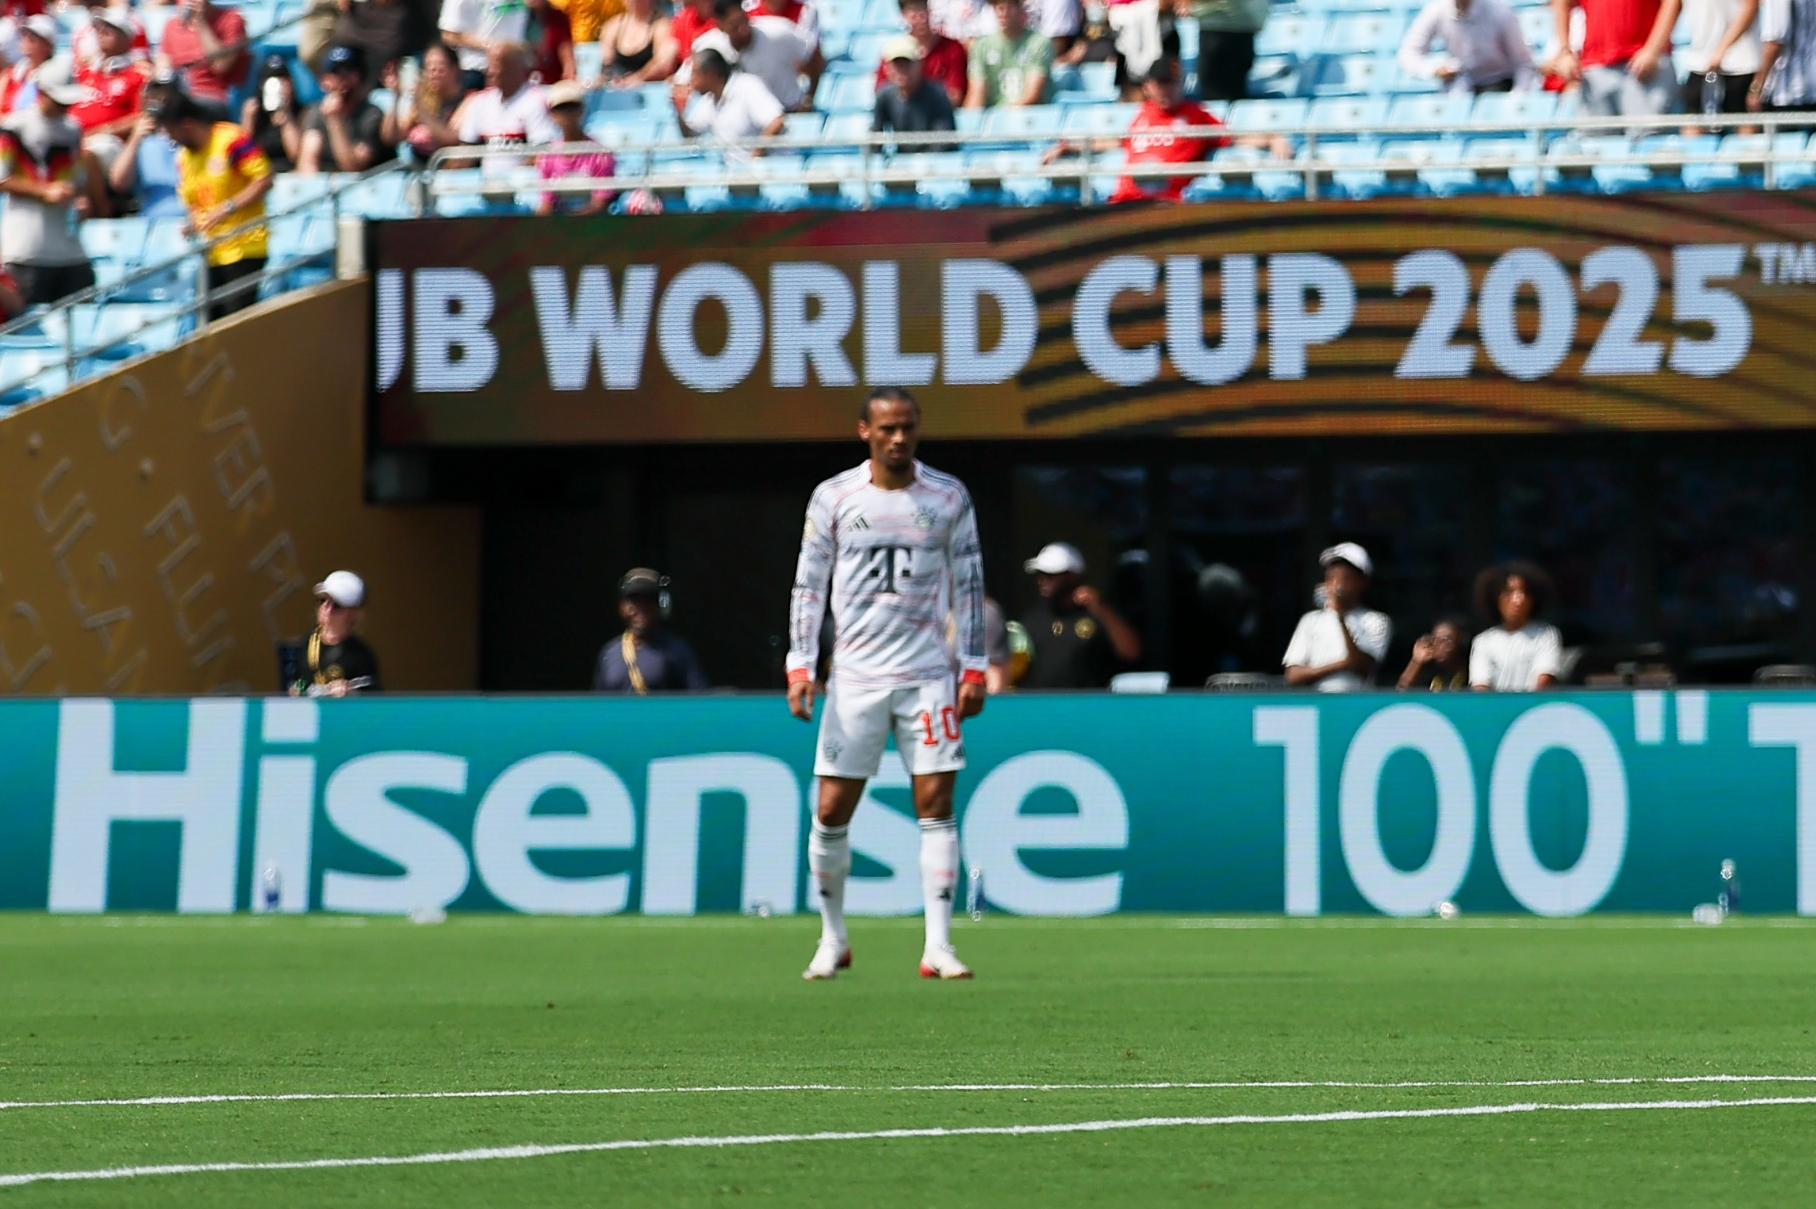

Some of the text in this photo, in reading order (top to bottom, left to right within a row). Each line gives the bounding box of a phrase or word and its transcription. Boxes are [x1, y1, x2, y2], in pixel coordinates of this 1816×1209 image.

[377, 266, 499, 393] B
[530, 258, 1040, 392] WORLD
[1072, 252, 1356, 387] CUP
[921, 705, 960, 746] 10
[47, 697, 1131, 917] Hisense
